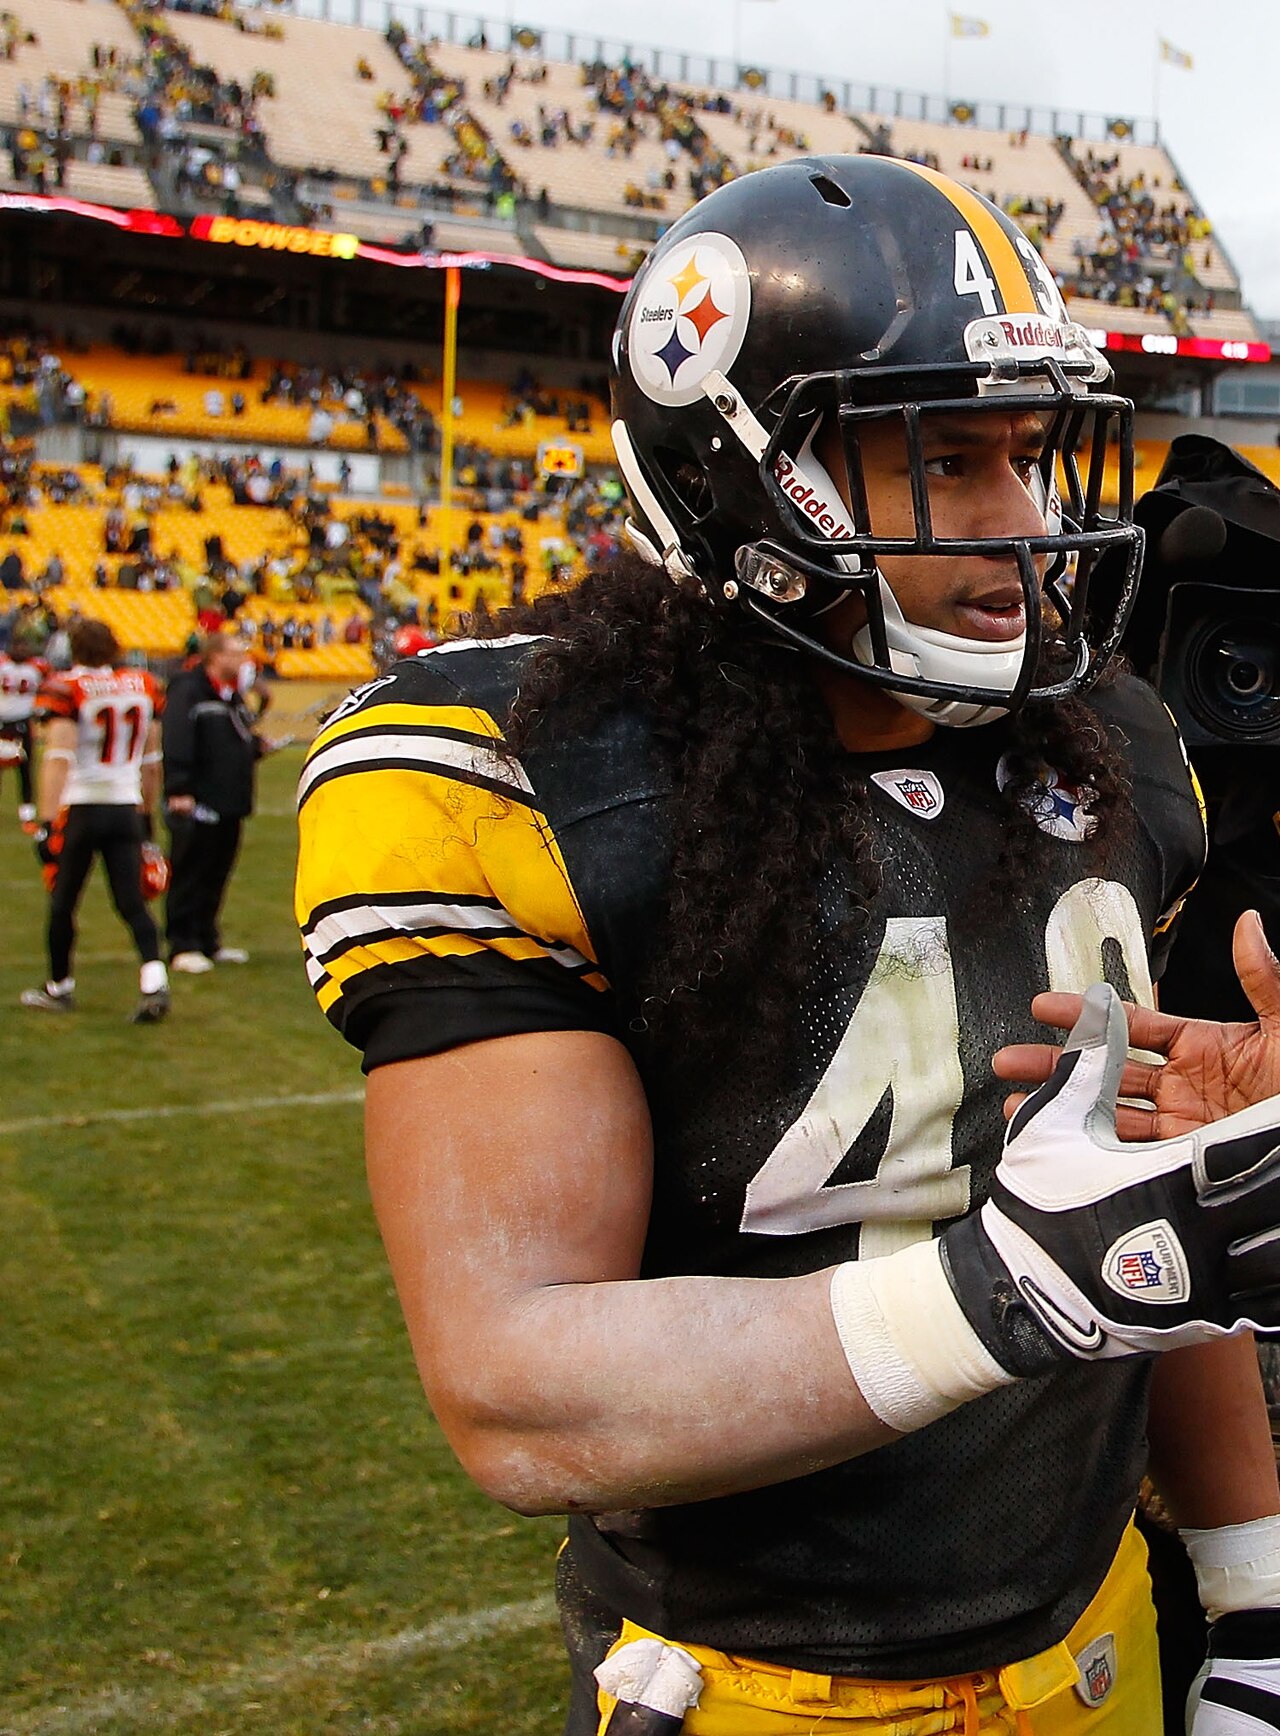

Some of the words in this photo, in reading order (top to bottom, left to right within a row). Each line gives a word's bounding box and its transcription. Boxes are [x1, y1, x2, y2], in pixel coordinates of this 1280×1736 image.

[640, 305, 674, 323] Steelers
[903, 791, 934, 809] NFL
[1121, 1256, 1146, 1288] NFL
[1151, 1232, 1180, 1296] EQUIPMENT
